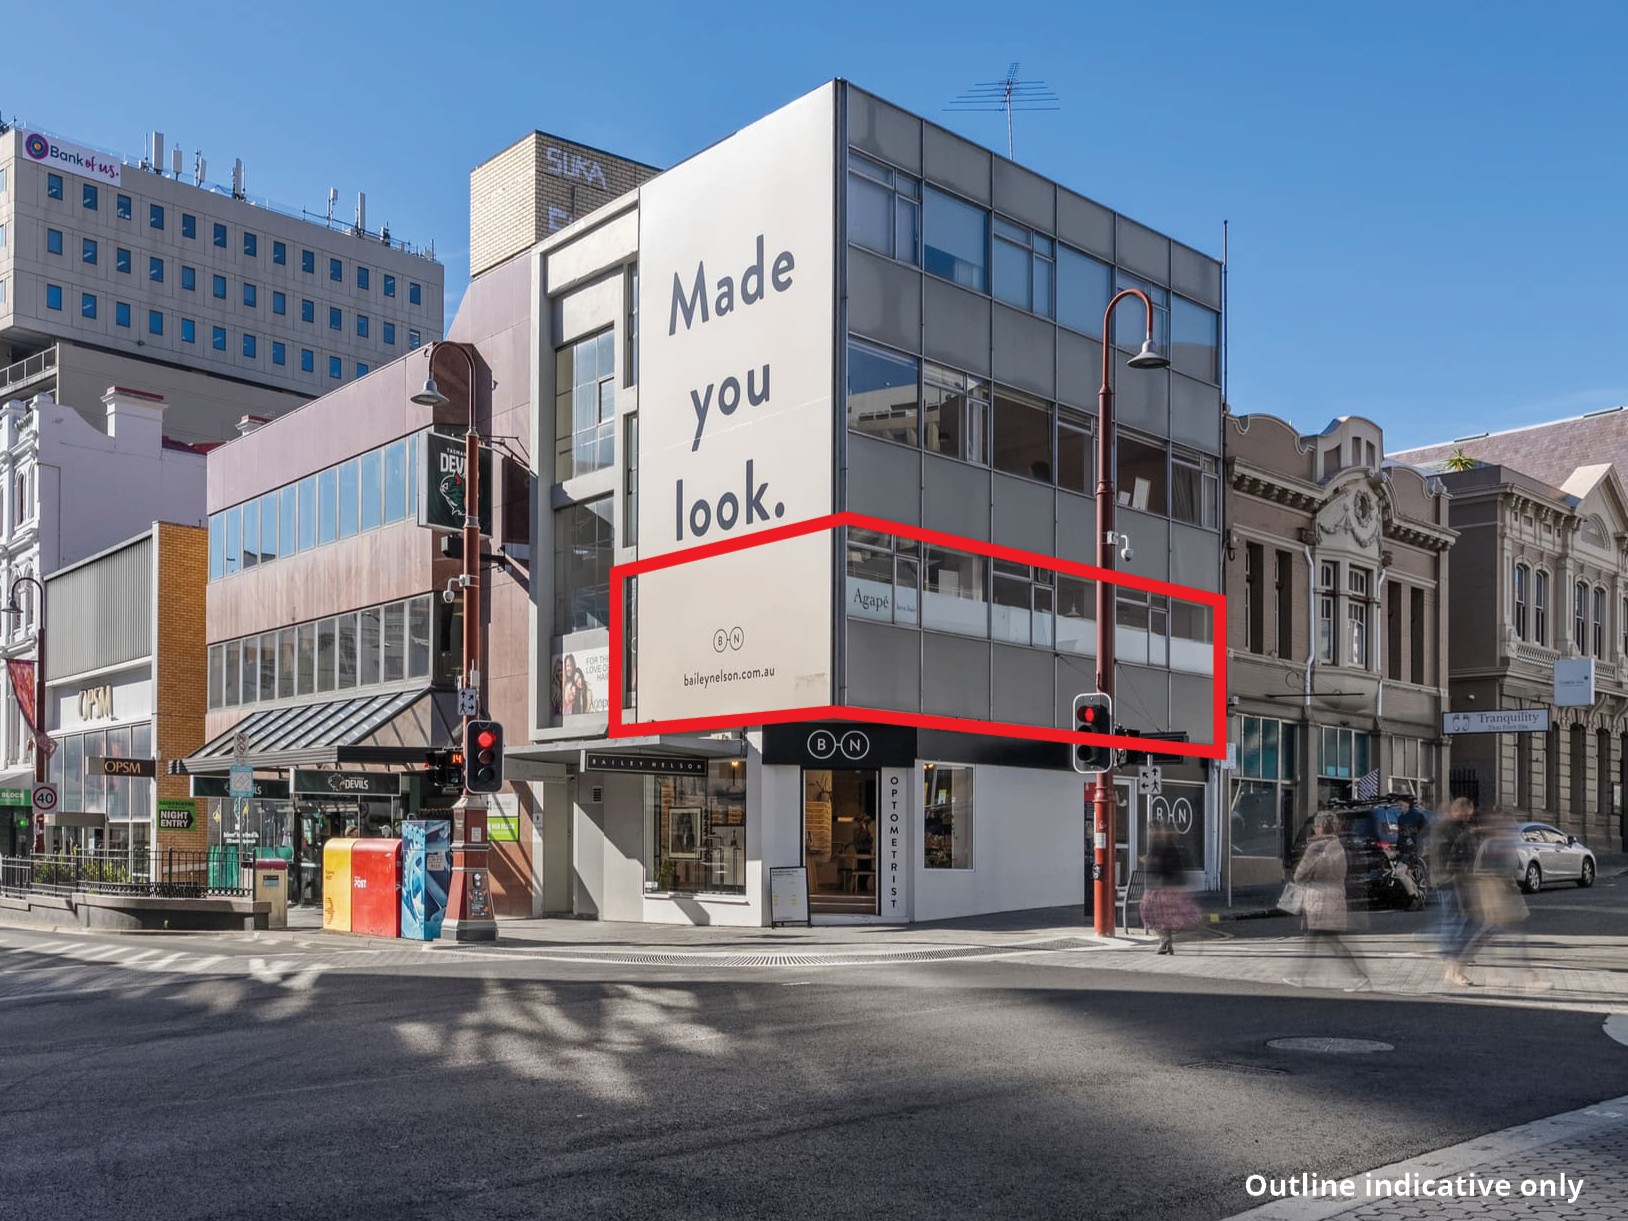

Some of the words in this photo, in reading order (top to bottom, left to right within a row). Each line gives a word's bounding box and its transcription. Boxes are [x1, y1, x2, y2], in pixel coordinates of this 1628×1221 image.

[50, 145, 84, 167] Bank
[85, 156, 97, 172] of
[99, 163, 119, 178] us.
[668, 234, 795, 336] Made
[690, 364, 770, 452] you
[676, 459, 785, 541] look.
[853, 587, 889, 611] Agapé
[683, 667, 775, 689] baileynelson.com.au
[78, 684, 113, 720] OPSM
[1475, 711, 1539, 724] Tranquility
[104, 761, 141, 774] OPSM
[452, 754, 462, 764] 14
[592, 758, 643, 767] BAILEY
[651, 761, 702, 770] NELSON
[345, 779, 369, 790] DEVILS
[37, 792, 54, 804] 40
[160, 810, 189, 820] NIGHT
[160, 819, 189, 828] ENTRY
[889, 776, 900, 909] OPTOMETRIST
